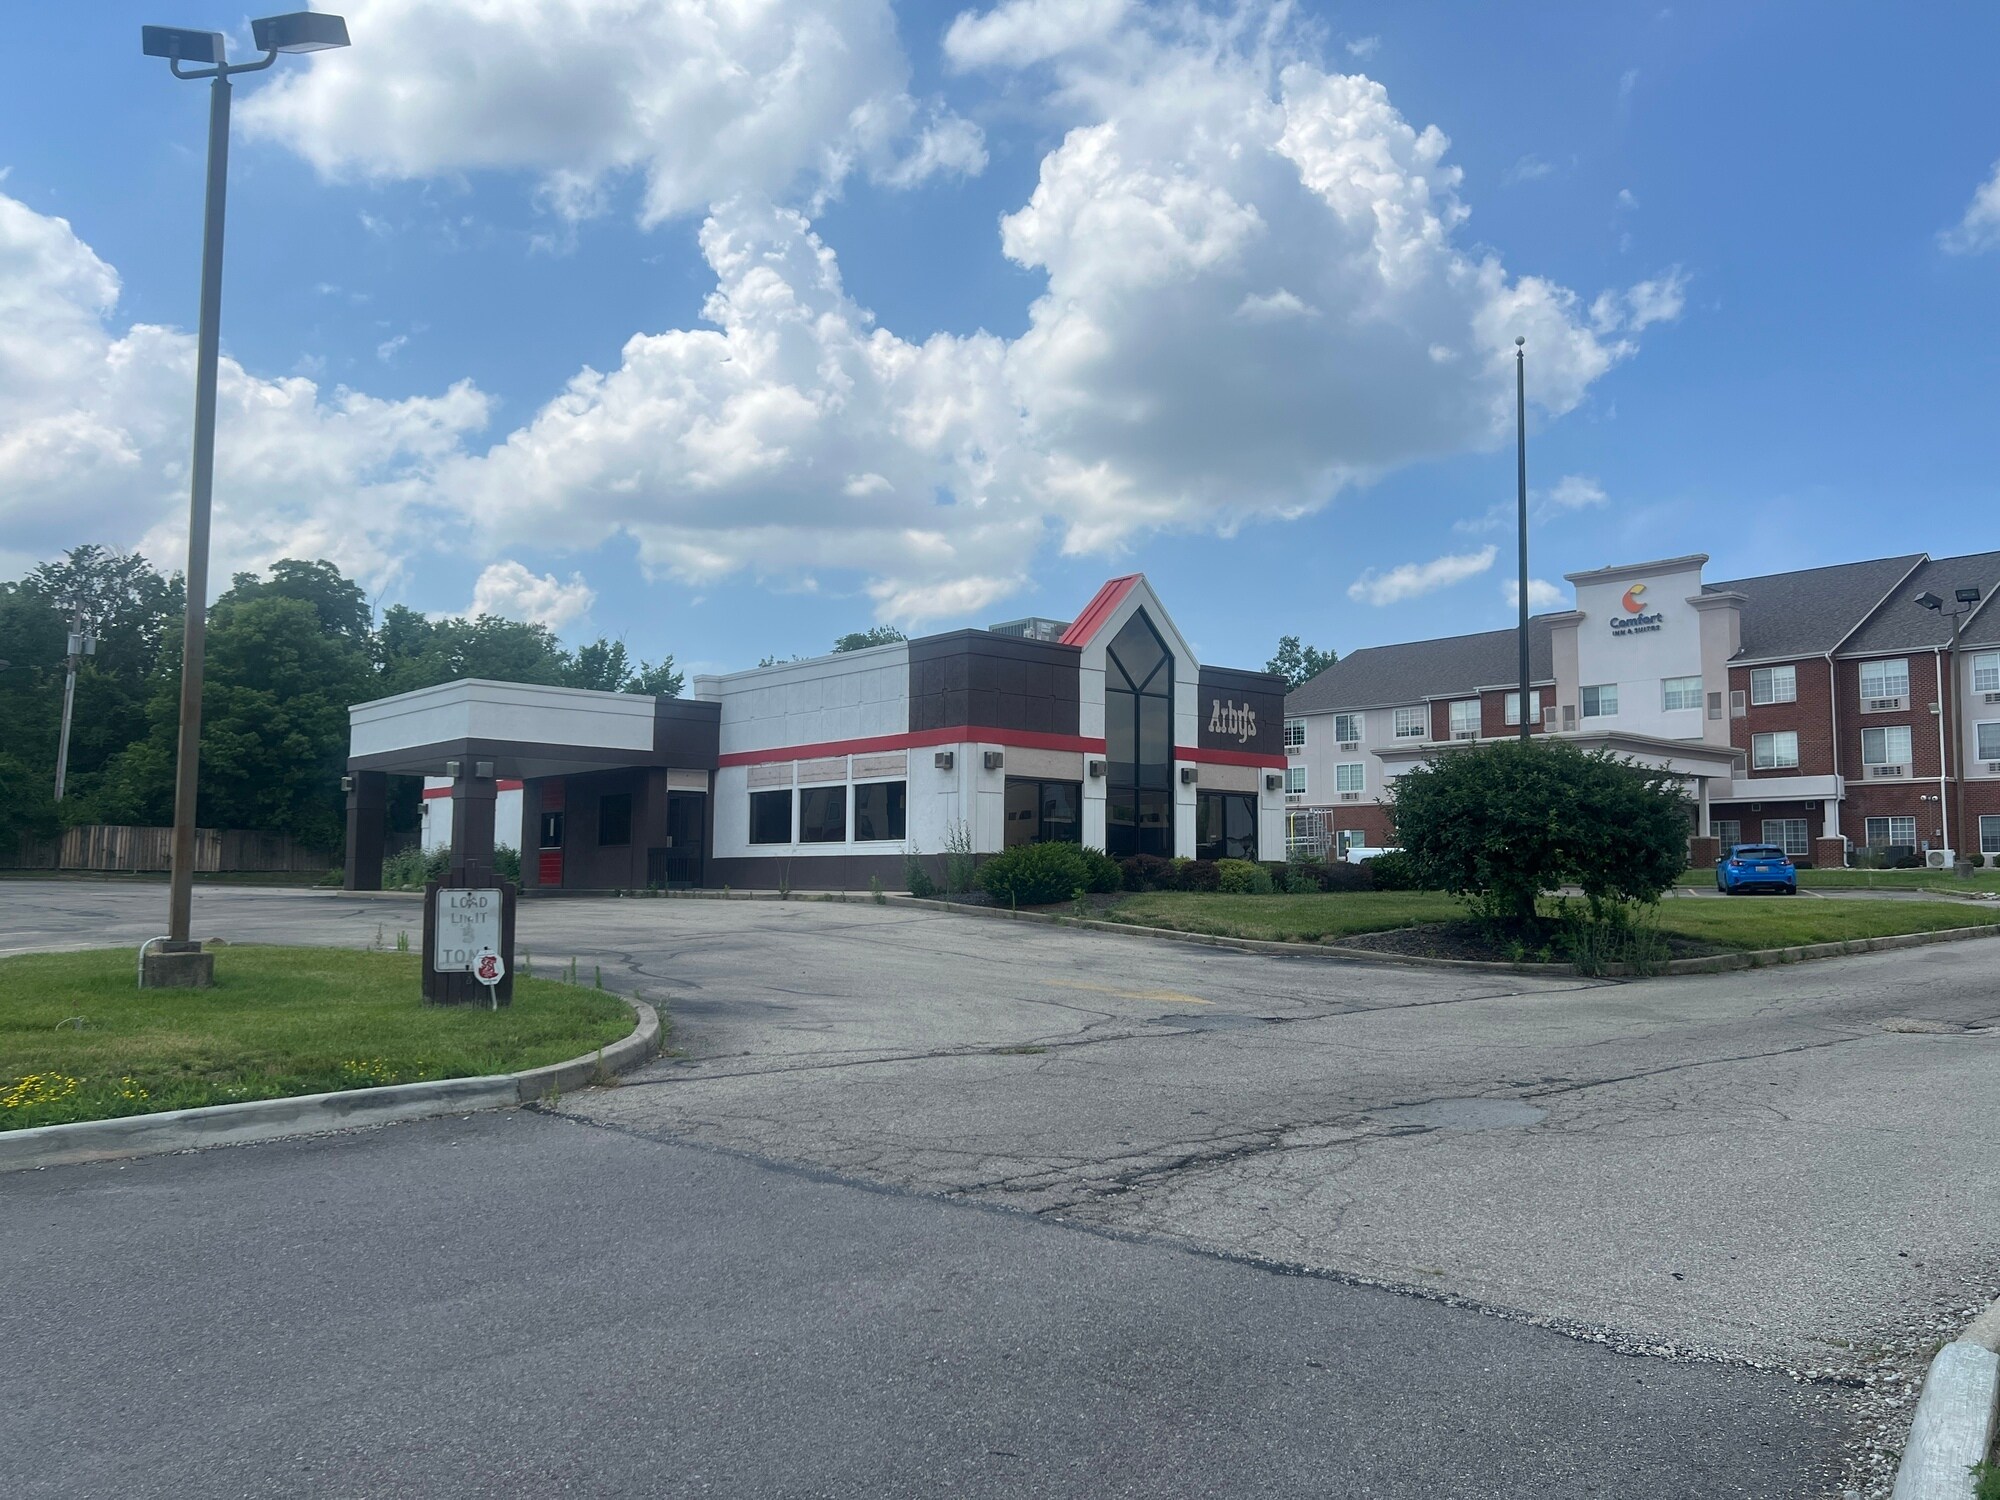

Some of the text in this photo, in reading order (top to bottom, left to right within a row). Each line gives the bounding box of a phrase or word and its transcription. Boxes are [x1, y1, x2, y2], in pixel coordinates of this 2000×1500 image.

[1610, 613, 1663, 629] Comfort
[1208, 699, 1257, 744] Arby's
[451, 896, 488, 908] LOAD
[451, 912, 488, 924] LIMIT
